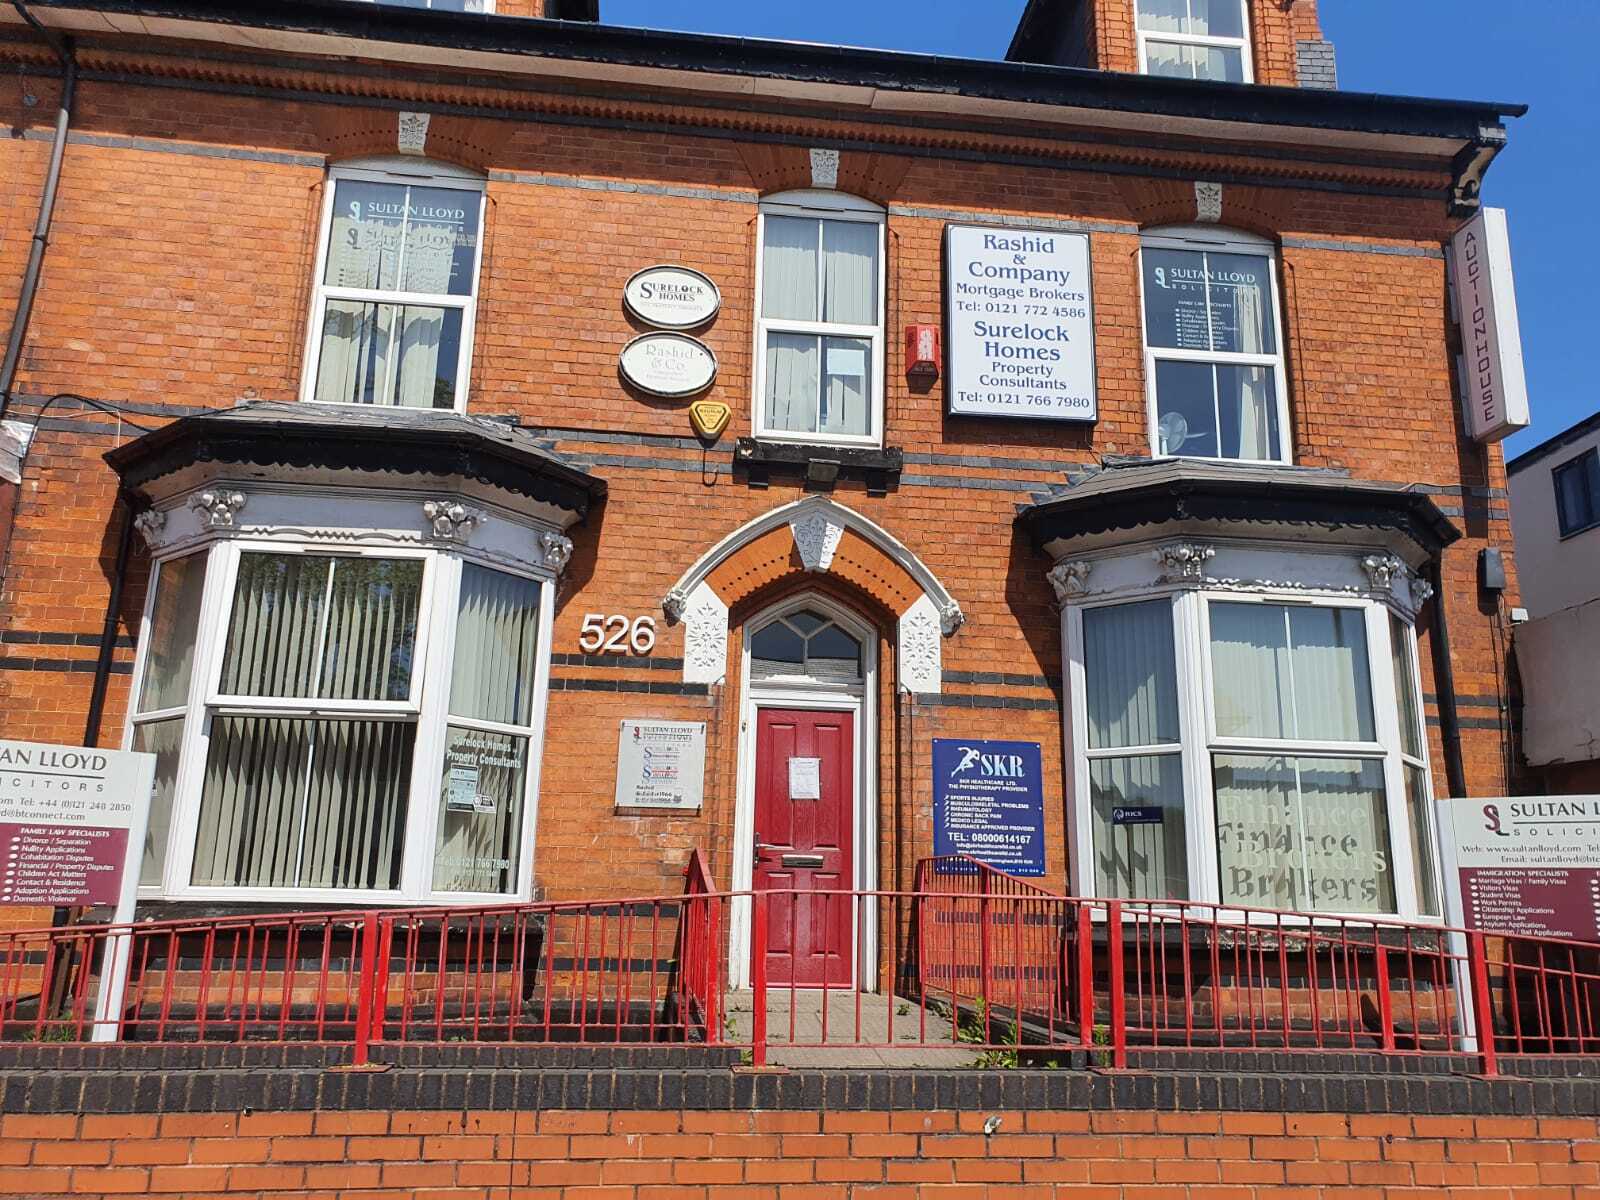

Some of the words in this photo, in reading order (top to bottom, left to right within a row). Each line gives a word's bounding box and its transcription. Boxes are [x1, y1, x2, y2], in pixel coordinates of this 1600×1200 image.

[368, 202, 418, 216] SULTAN
[422, 207, 464, 219] LLOYD
[984, 234, 1054, 253] Rashid
[1012, 254, 1026, 265] &
[968, 262, 1070, 286] Company
[1171, 268, 1214, 280] SULTAN
[1218, 272, 1256, 283] LLOYD
[640, 282, 704, 298] SURELOCK
[659, 292, 695, 302] HOMES
[956, 282, 1024, 300] Mortgage
[1030, 288, 1084, 300] Brokers
[956, 301, 981, 312] Tel:
[986, 302, 1018, 314] 0121
[1024, 304, 1048, 316] 772
[1052, 306, 1086, 318] 4586
[974, 320, 1070, 342] Surelock
[646, 344, 694, 359] Rashid
[984, 342, 1060, 361] Homes
[992, 362, 1053, 378] Property
[980, 374, 1066, 390] Consultants
[958, 392, 982, 402] Tel:
[988, 393, 1020, 404] 0121
[1027, 395, 1050, 406] 766
[1056, 396, 1090, 408] 7980
[579, 614, 656, 654] 526
[40, 751, 107, 771] LLOYD
[447, 750, 478, 764] Property
[480, 754, 521, 768] Consultants
[980, 754, 1024, 778] SKR
[1510, 802, 1585, 817] SULTAN
[948, 832, 969, 841] TEL:
[55, 863, 85, 871] Property
[87, 864, 114, 872] Disputes
